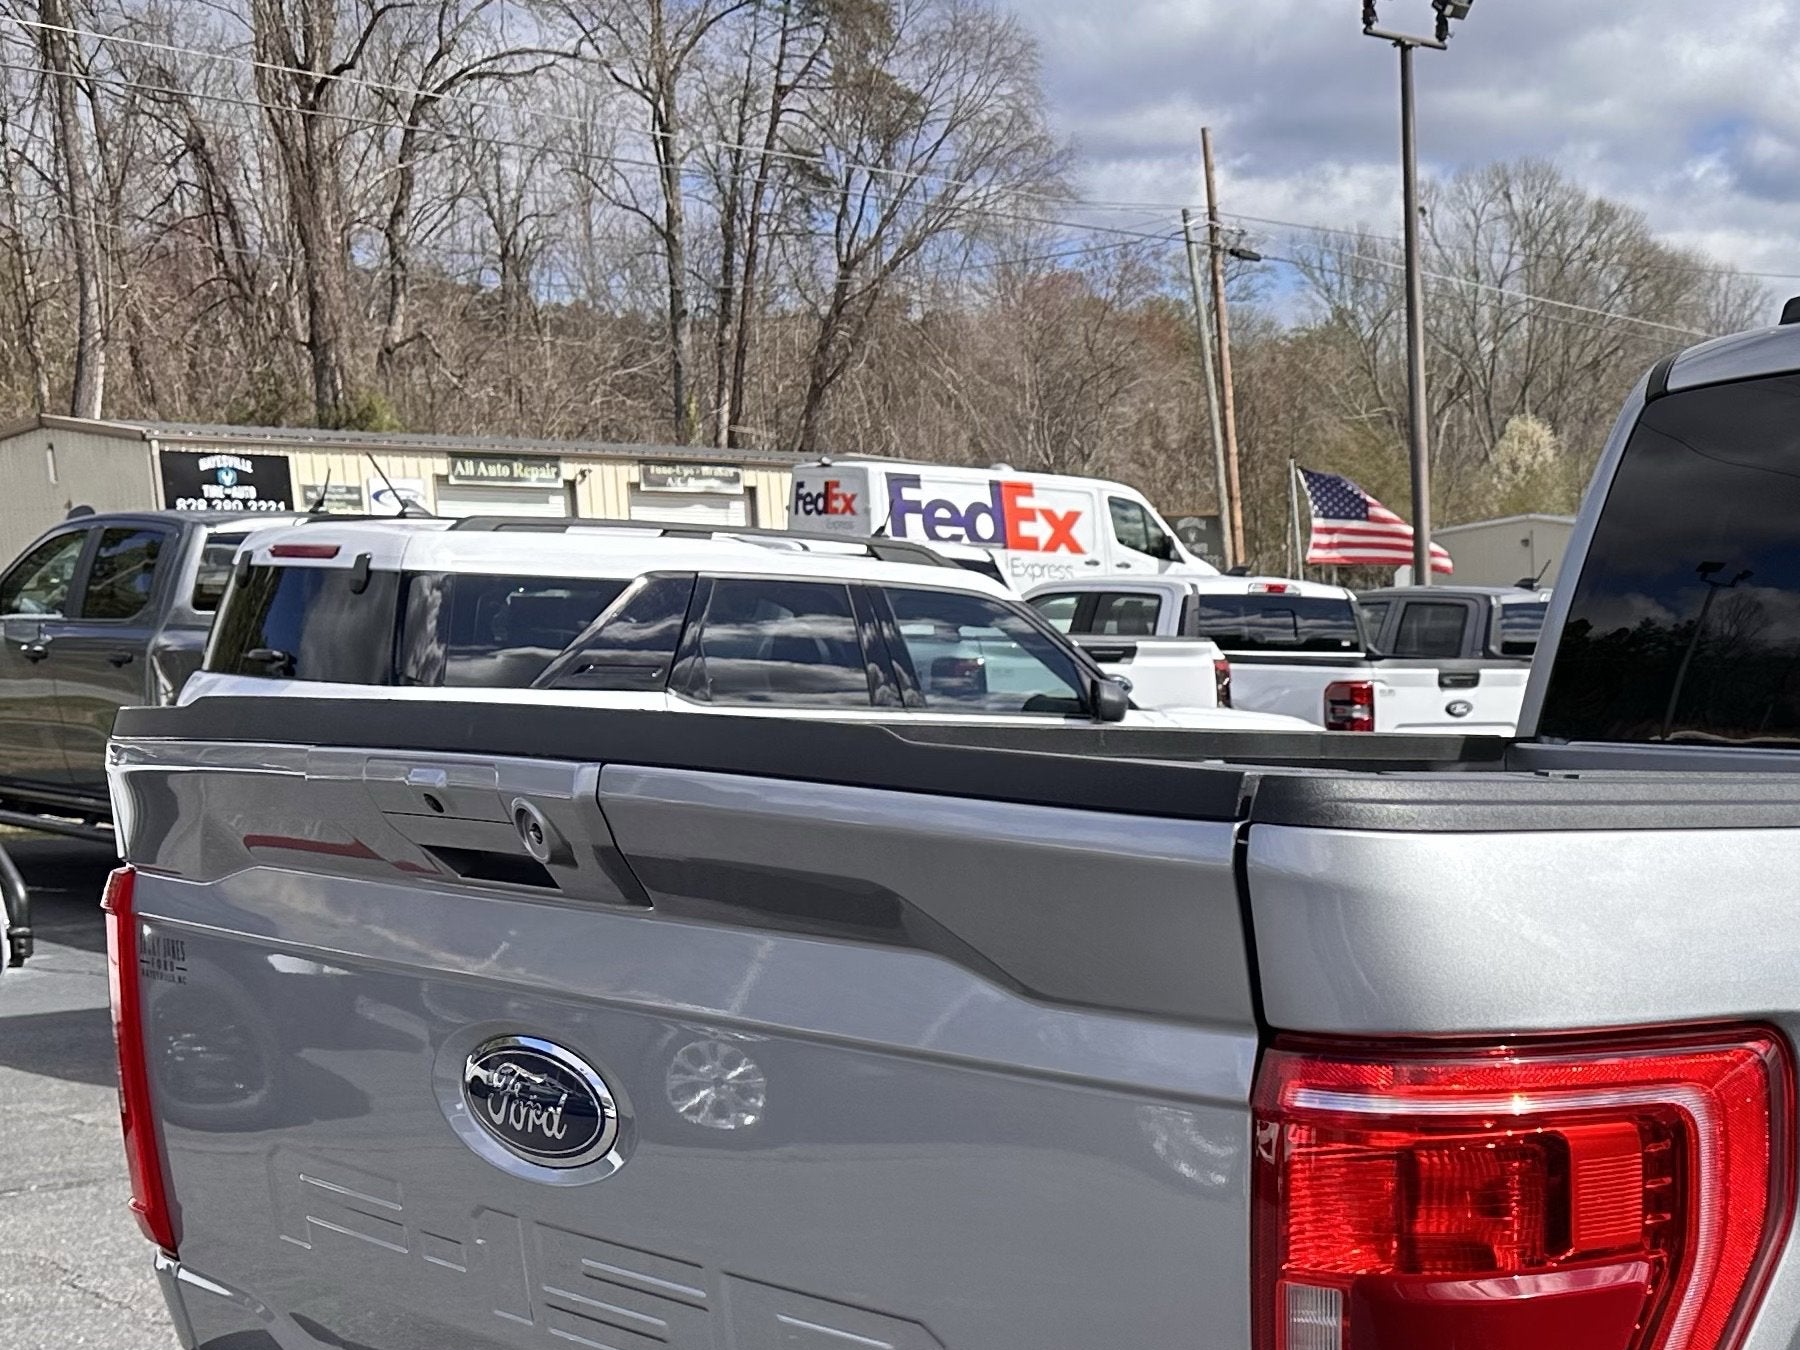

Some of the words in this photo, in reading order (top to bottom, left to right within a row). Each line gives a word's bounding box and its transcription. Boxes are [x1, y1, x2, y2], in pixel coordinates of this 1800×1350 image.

[454, 460, 475, 476] All
[477, 461, 510, 477] Auto
[512, 461, 558, 482] Repair
[795, 480, 857, 515] FedEx
[885, 472, 1087, 554] FedEx
[1010, 558, 1075, 580] Express
[487, 1061, 568, 1140] Ford
